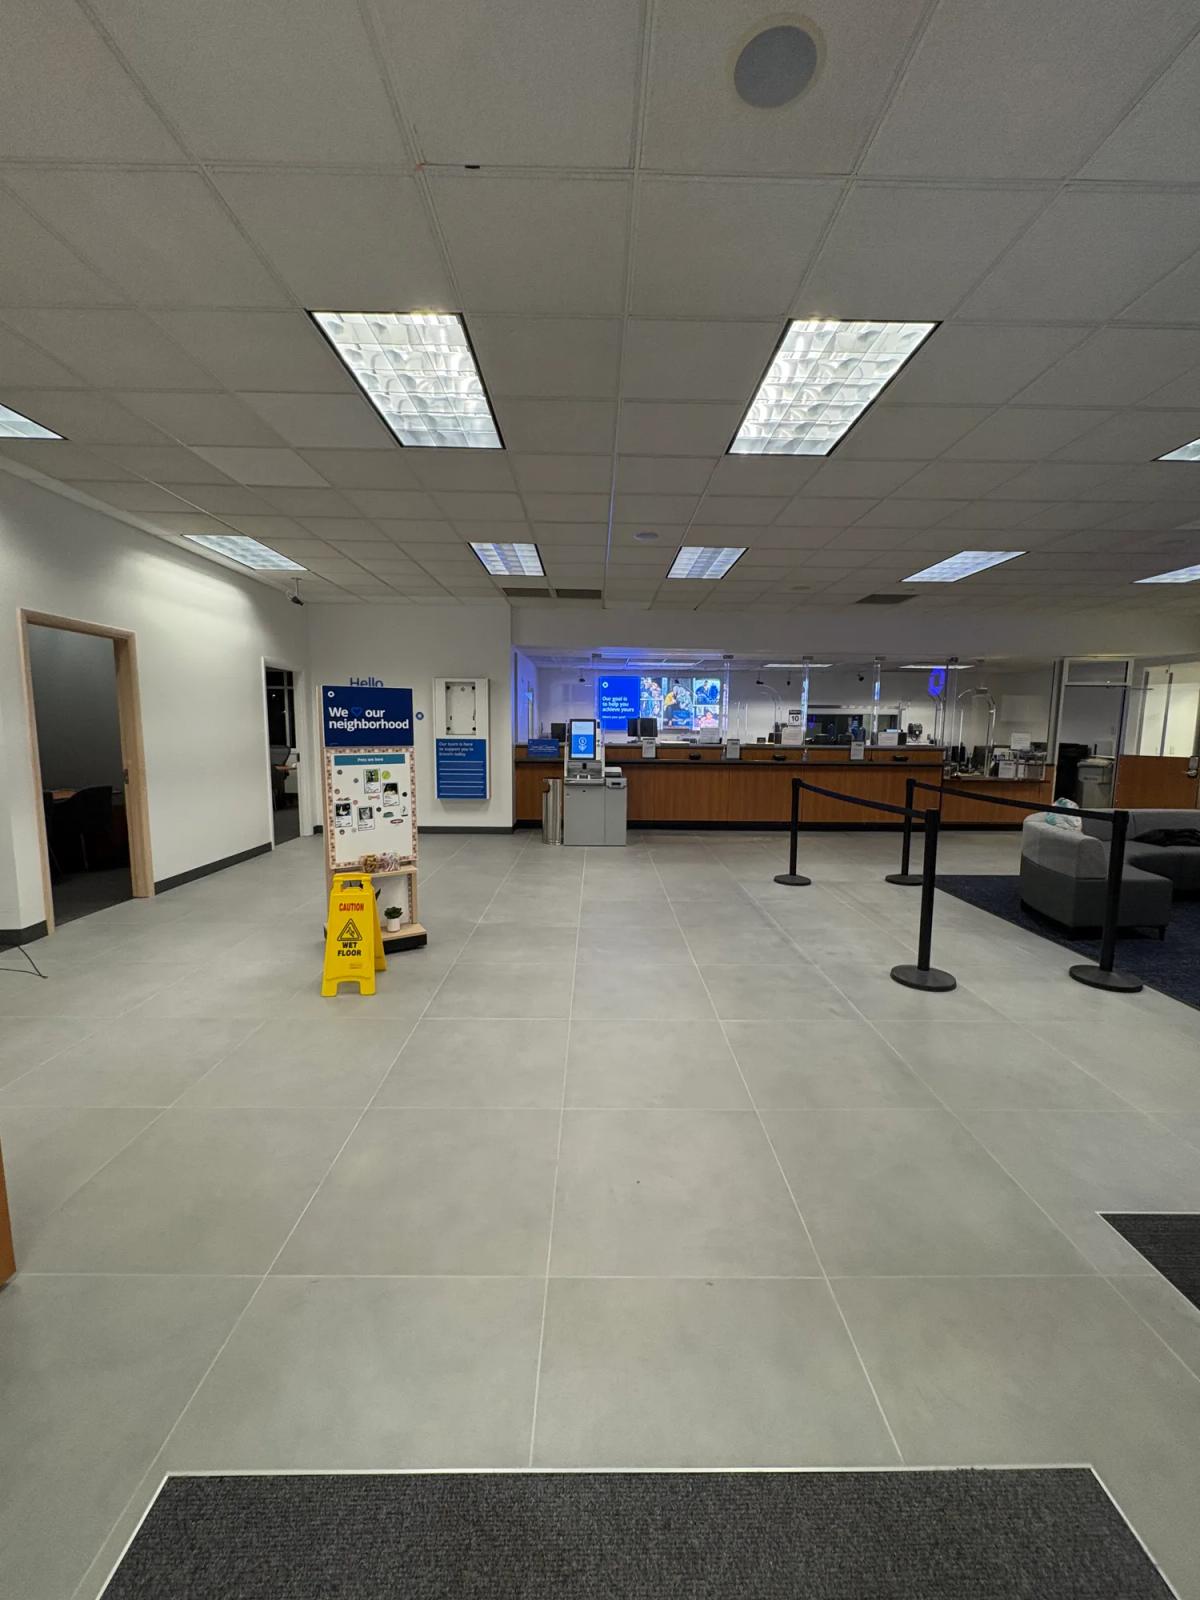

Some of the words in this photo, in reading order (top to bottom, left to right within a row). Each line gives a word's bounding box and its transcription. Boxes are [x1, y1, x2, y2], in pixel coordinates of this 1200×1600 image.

[328, 707, 349, 718] We
[365, 709, 385, 718] our
[328, 718, 409, 732] neighborhood
[339, 903, 364, 911] CAUTION
